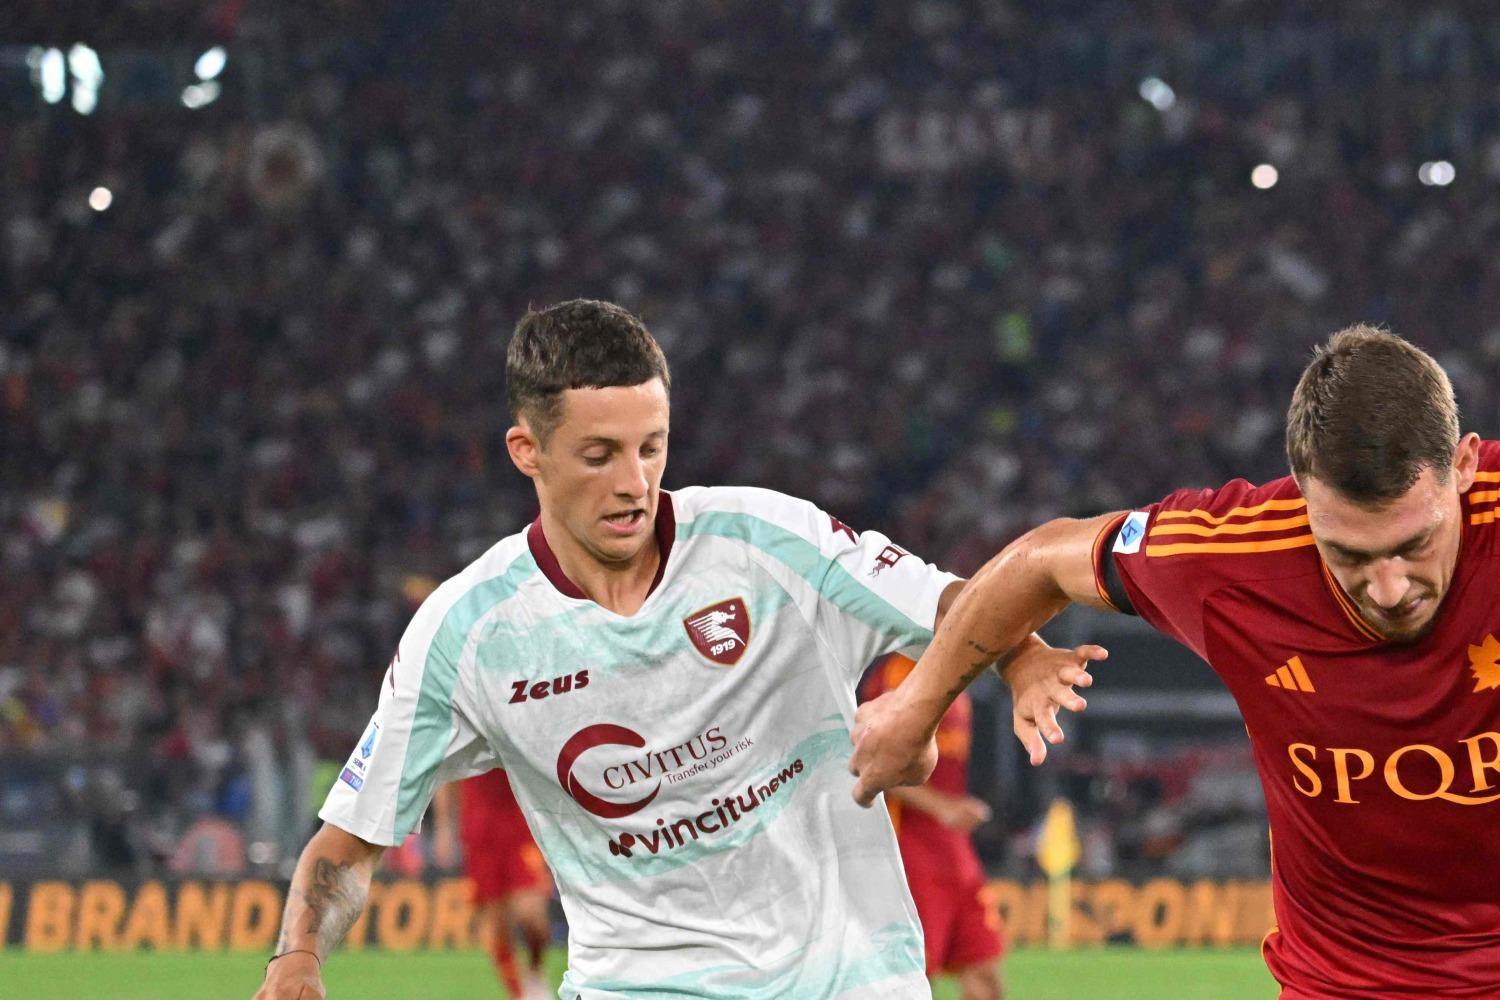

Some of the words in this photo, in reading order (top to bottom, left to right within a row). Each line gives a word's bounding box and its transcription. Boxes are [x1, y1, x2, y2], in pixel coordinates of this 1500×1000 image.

[709, 639, 737, 656] 1919
[603, 726, 728, 790] CIVITUS
[666, 762, 710, 785] Transfer
[709, 748, 734, 769] your
[734, 736, 755, 753] risk
[25, 879, 282, 953] BRAND
